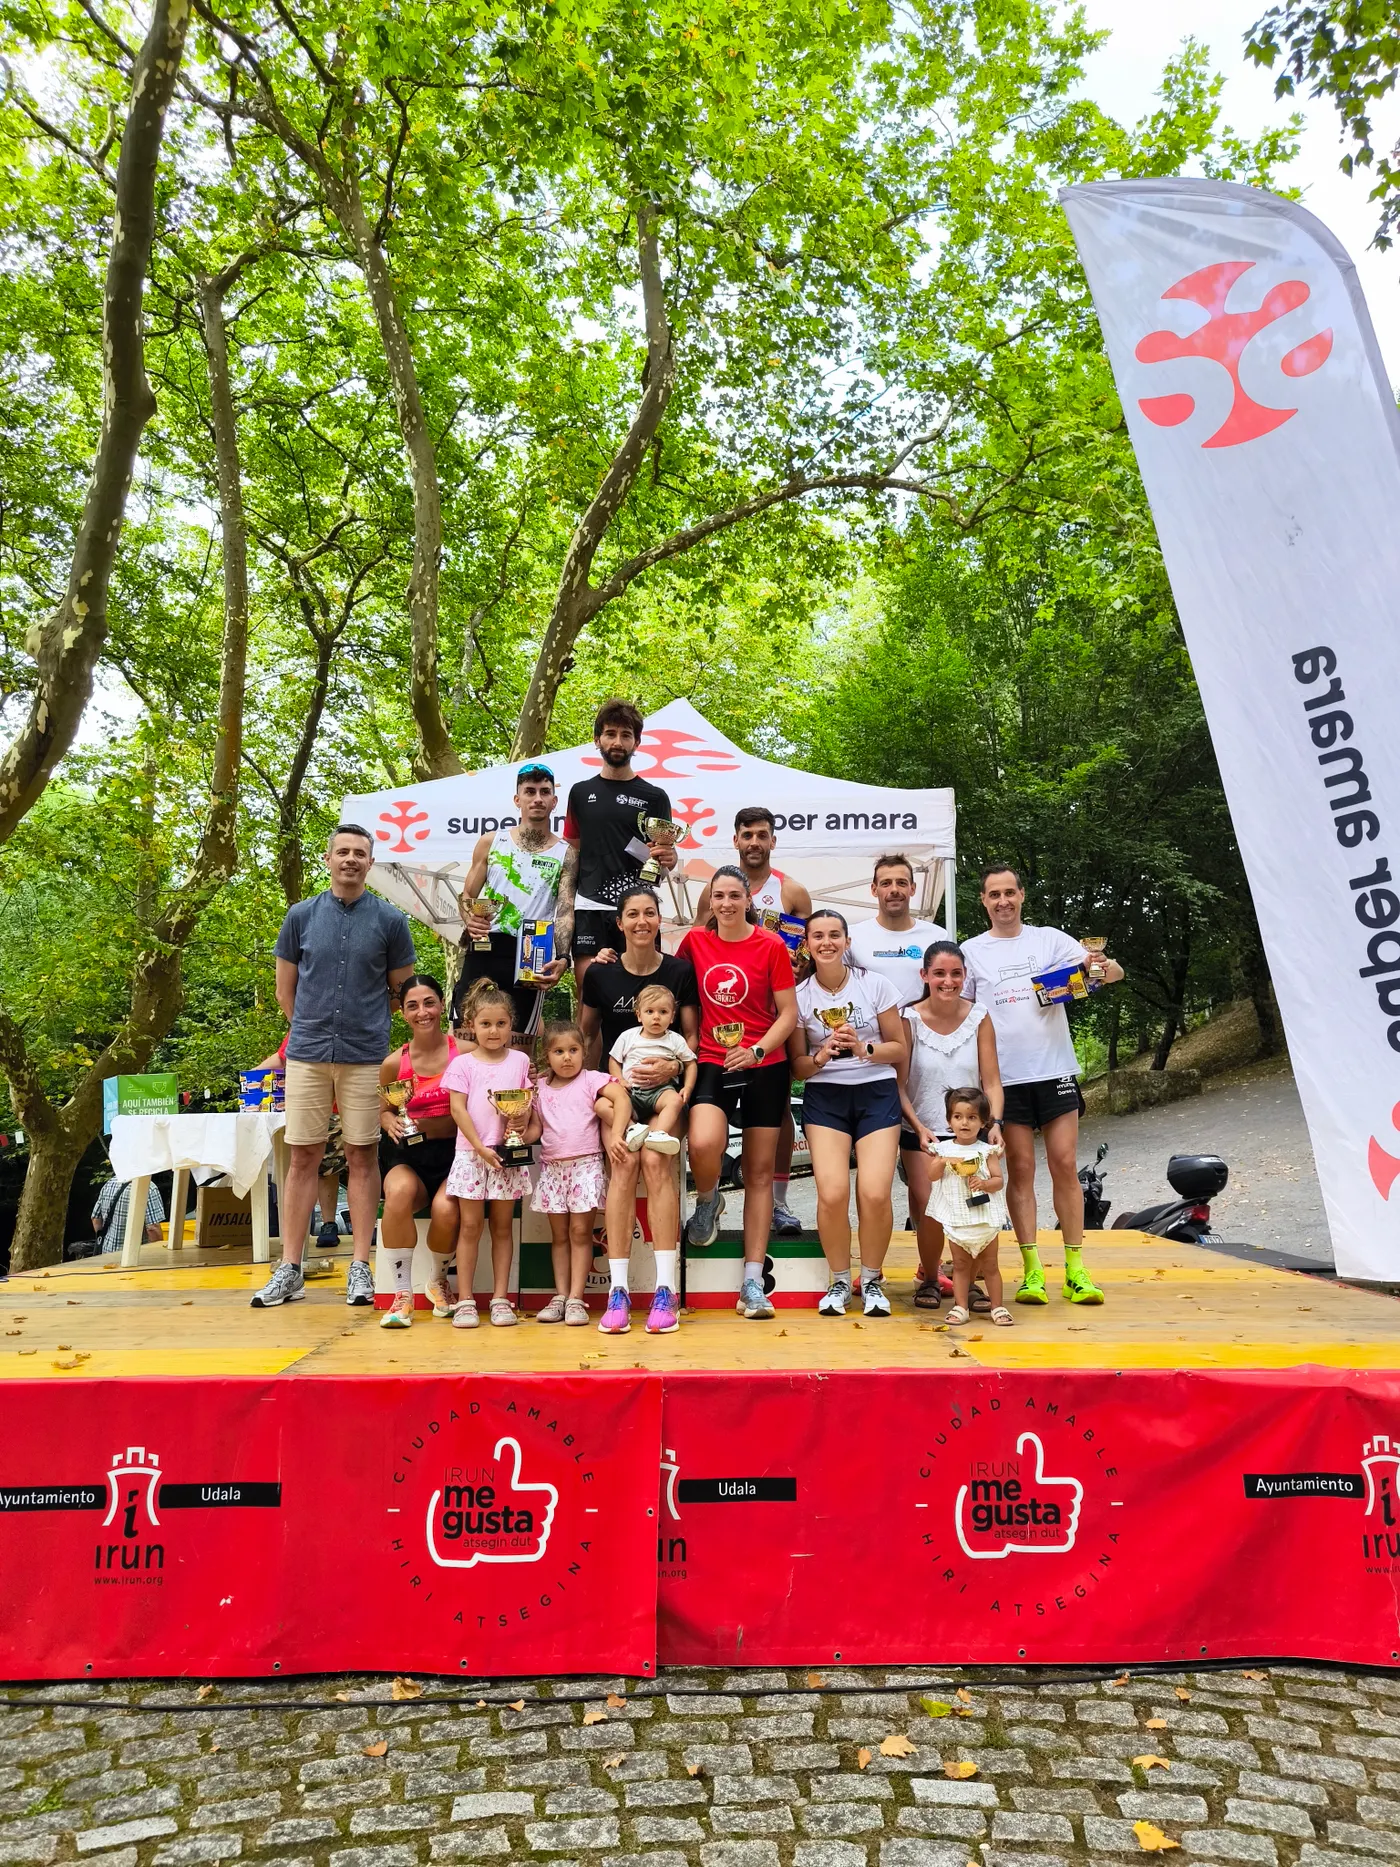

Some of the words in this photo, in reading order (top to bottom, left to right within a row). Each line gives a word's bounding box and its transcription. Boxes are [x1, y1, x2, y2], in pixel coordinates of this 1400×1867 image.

[447, 816, 521, 836] supe
[774, 813, 818, 831] per
[825, 813, 918, 831] amara
[122, 1096, 141, 1108] AQUÍ
[143, 1094, 174, 1107] TAMBIÉN
[393, 1402, 481, 1484] CIUDAD
[506, 1401, 594, 1483] AMABLE
[920, 1399, 1001, 1478] CIUDAD
[1025, 1397, 1118, 1478] AMABLE
[443, 1467, 495, 1483] IRUN
[970, 1461, 1019, 1477] IRUN
[201, 1486, 241, 1501] Udala
[718, 1481, 757, 1496] Udala
[971, 1479, 1022, 1501] me
[1256, 1476, 1354, 1495] Ayuntamiento
[443, 1485, 496, 1508] me
[442, 1505, 533, 1539] gusta
[972, 1498, 1061, 1532] gusta
[463, 1537, 507, 1549] atsegin
[511, 1536, 532, 1547] dut
[994, 1528, 1037, 1539] atsegin
[1041, 1528, 1060, 1538] dut
[1362, 1532, 1400, 1558] iru
[94, 1543, 164, 1570] irun
[93, 1575, 163, 1585] www.irun.org
[391, 1539, 433, 1601] HIRI
[453, 1540, 592, 1629] ATSEGINA
[922, 1533, 967, 1593] HIRI
[990, 1533, 1120, 1616] ATSEGINA
